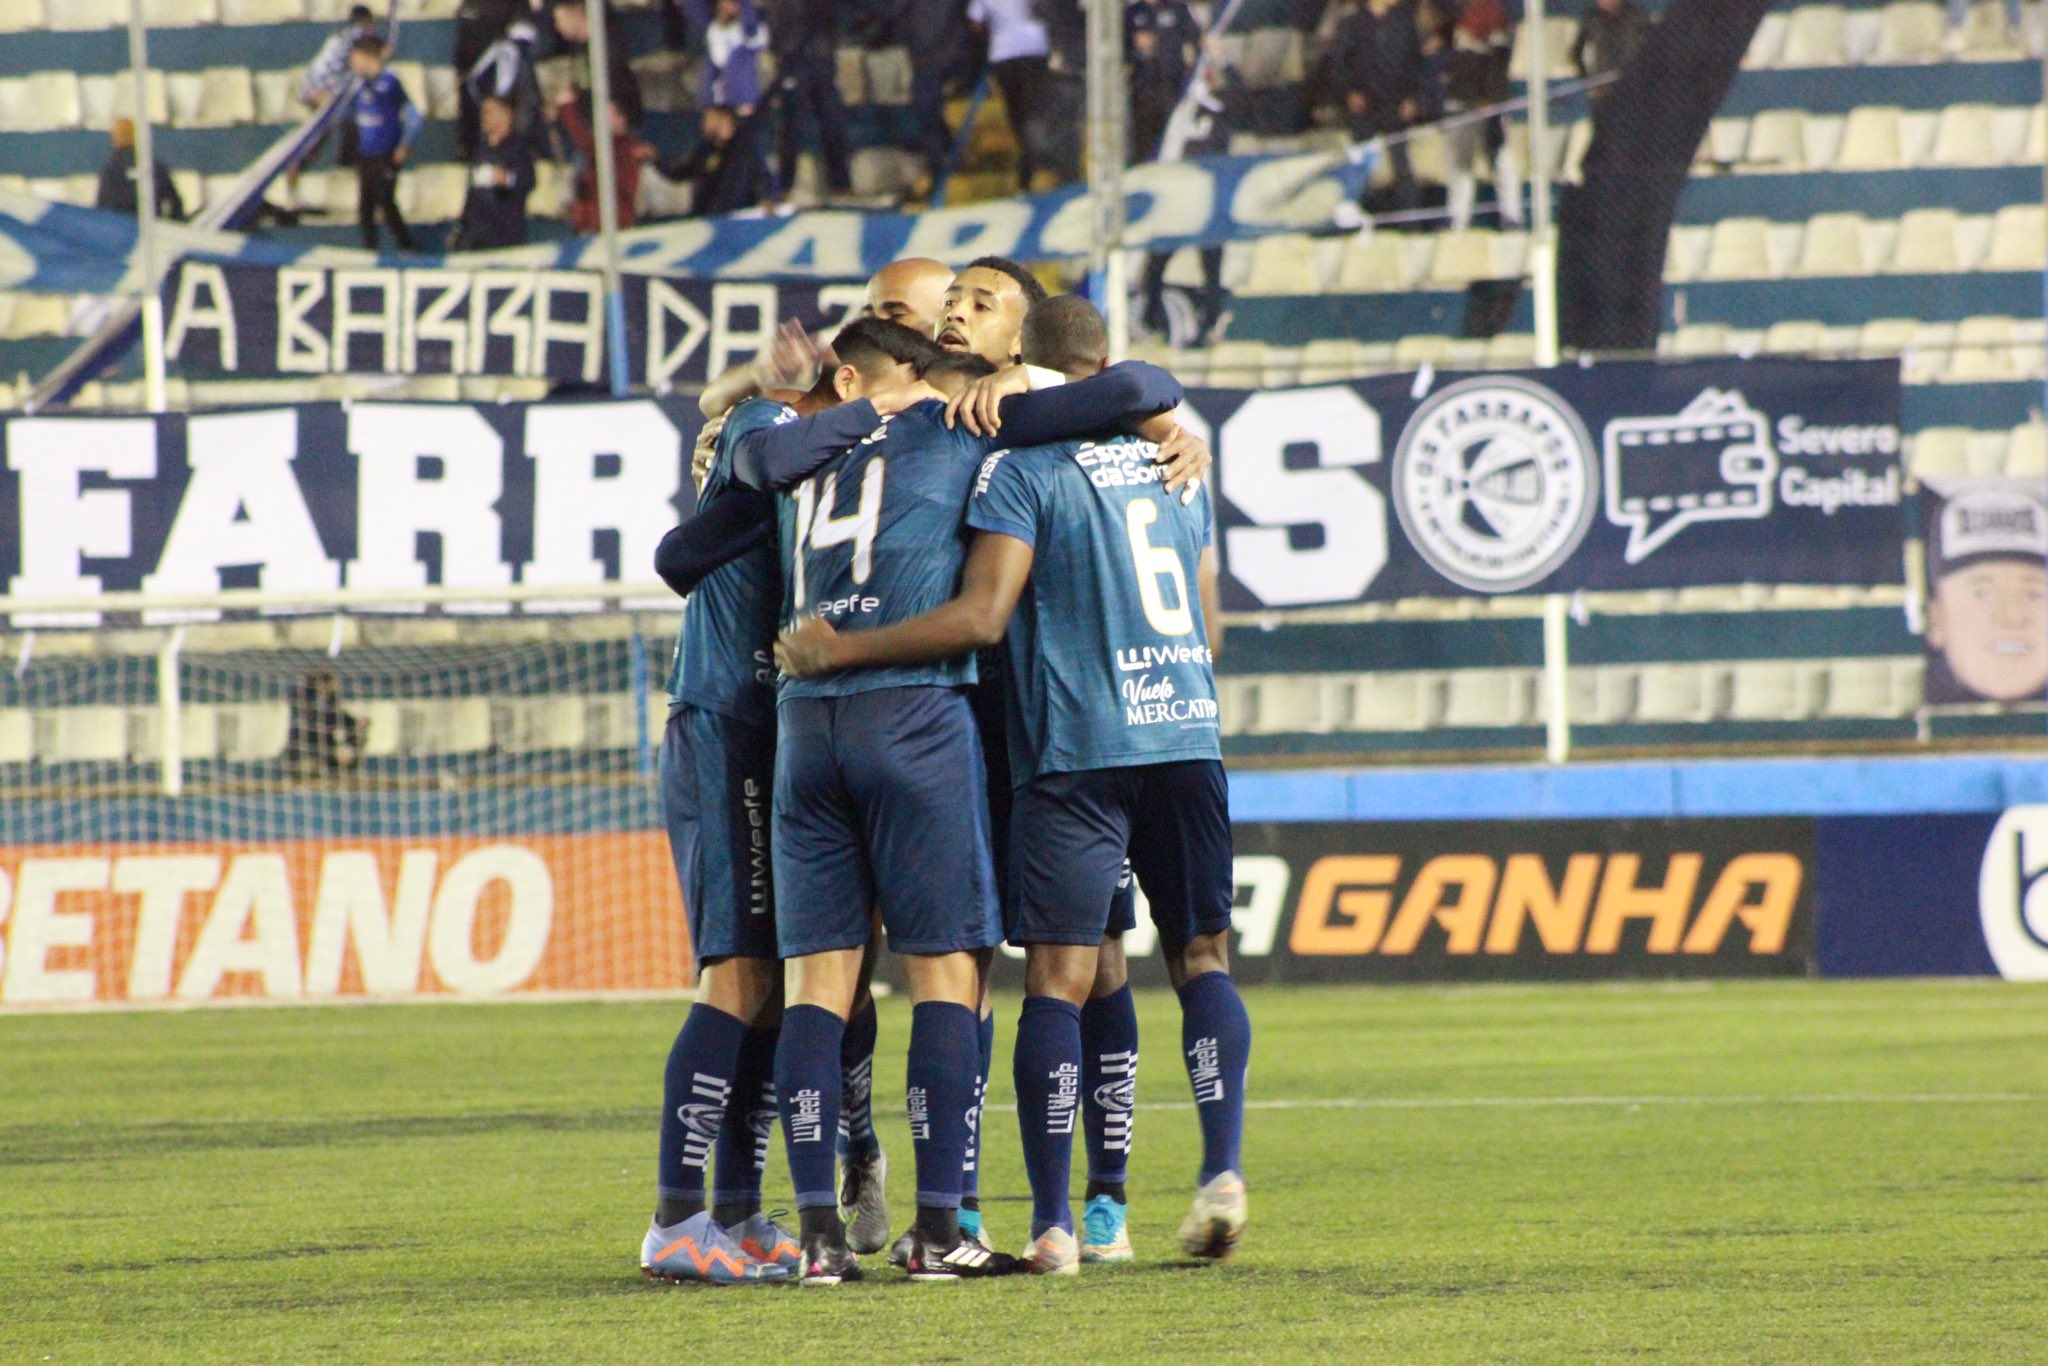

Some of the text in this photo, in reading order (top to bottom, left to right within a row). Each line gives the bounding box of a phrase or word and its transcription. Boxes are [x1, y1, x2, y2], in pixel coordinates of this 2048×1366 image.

[165, 262, 238, 372] A
[277, 268, 603, 383] BARRA
[646, 277, 778, 389] DA
[792, 456, 885, 609] 14
[1780, 465, 1900, 515] Capital
[1126, 498, 1193, 636] 6
[1122, 674, 1175, 706] Vuelo
[0, 844, 555, 1000] ETANO
[1289, 852, 1802, 956] GANHA
